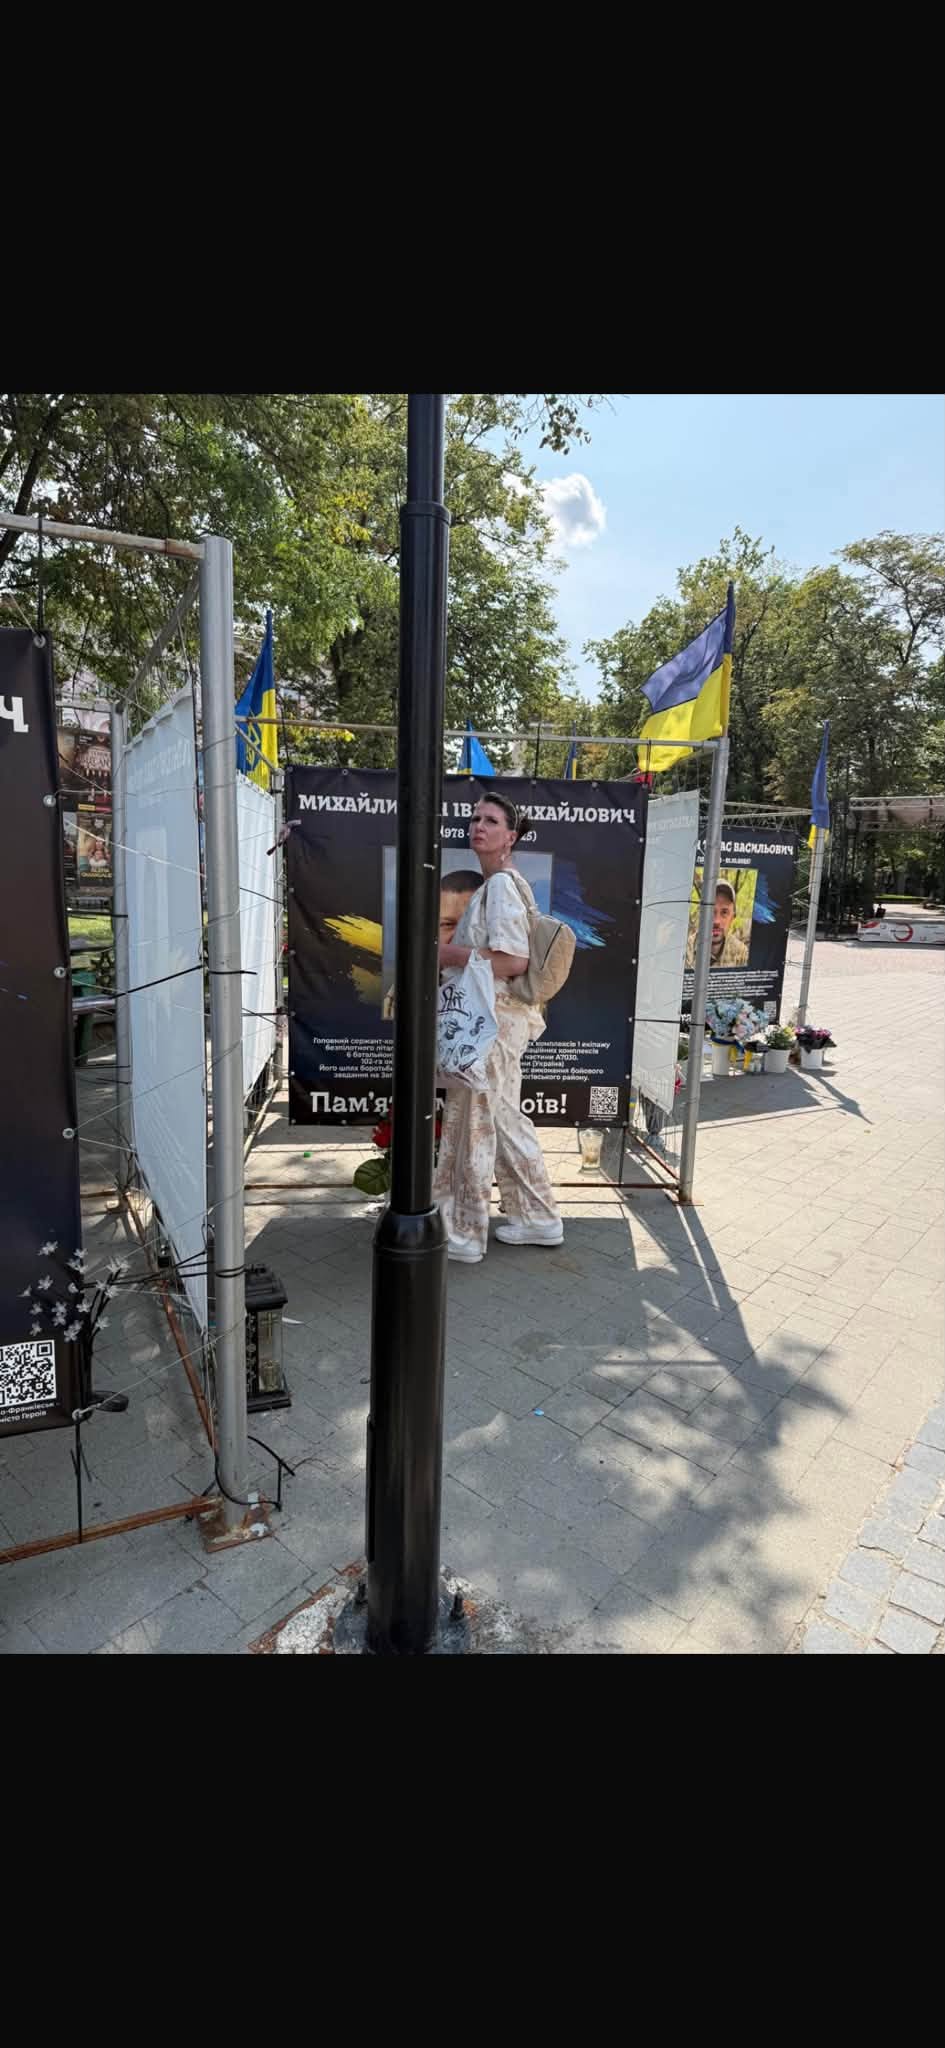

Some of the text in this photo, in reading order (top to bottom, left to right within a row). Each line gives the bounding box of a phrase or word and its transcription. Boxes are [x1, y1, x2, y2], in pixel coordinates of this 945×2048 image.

[452, 802, 476, 818] ІВ
[516, 801, 636, 824] ИХАЙЛОВИЧ
[733, 841, 794, 855] ВАСИЛЬОВИЧ
[313, 1036, 349, 1044] Головний
[350, 1038, 394, 1046] сержант-ко
[319, 1063, 337, 1071] Його
[520, 1091, 567, 1114] оїв!
[0, 1402, 54, 1415] о-Франківськ
